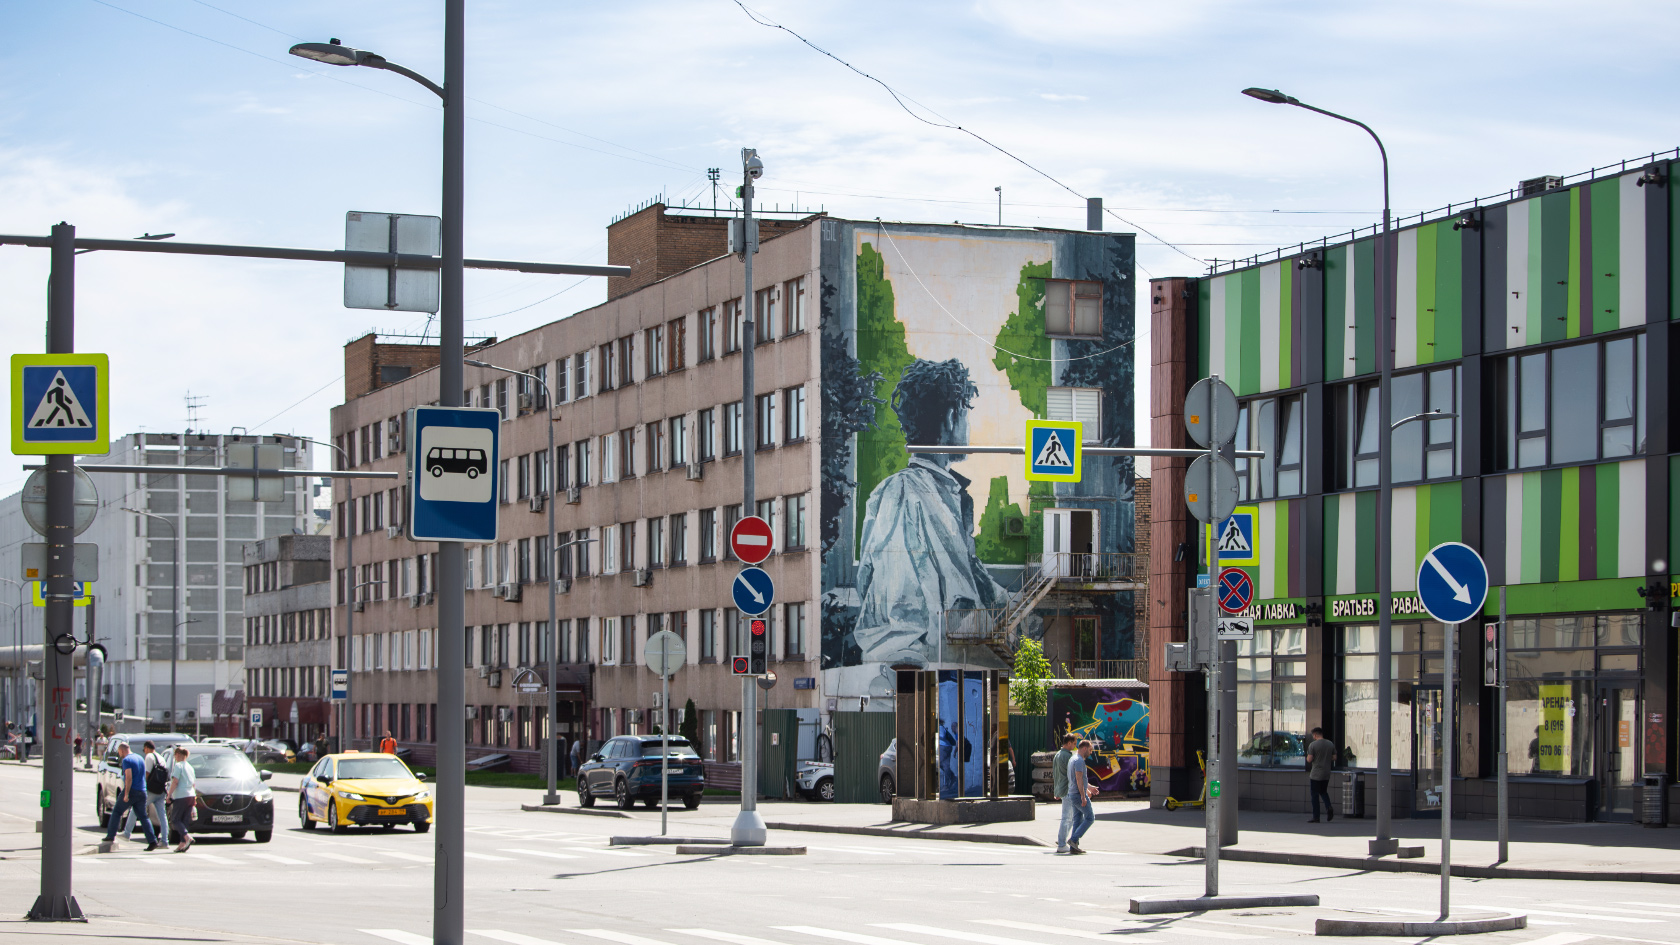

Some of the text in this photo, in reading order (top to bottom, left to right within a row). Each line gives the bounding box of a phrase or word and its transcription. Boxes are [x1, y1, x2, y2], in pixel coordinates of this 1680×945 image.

[1264, 603, 1296, 620] ЛАВКА
[1332, 598, 1375, 617] БРАТЬЕВ
[1541, 696, 1570, 710] АРЕНДА
[1544, 719, 1549, 731] 8
[1540, 744, 1552, 756] 970
[1553, 744, 1562, 756] 86
